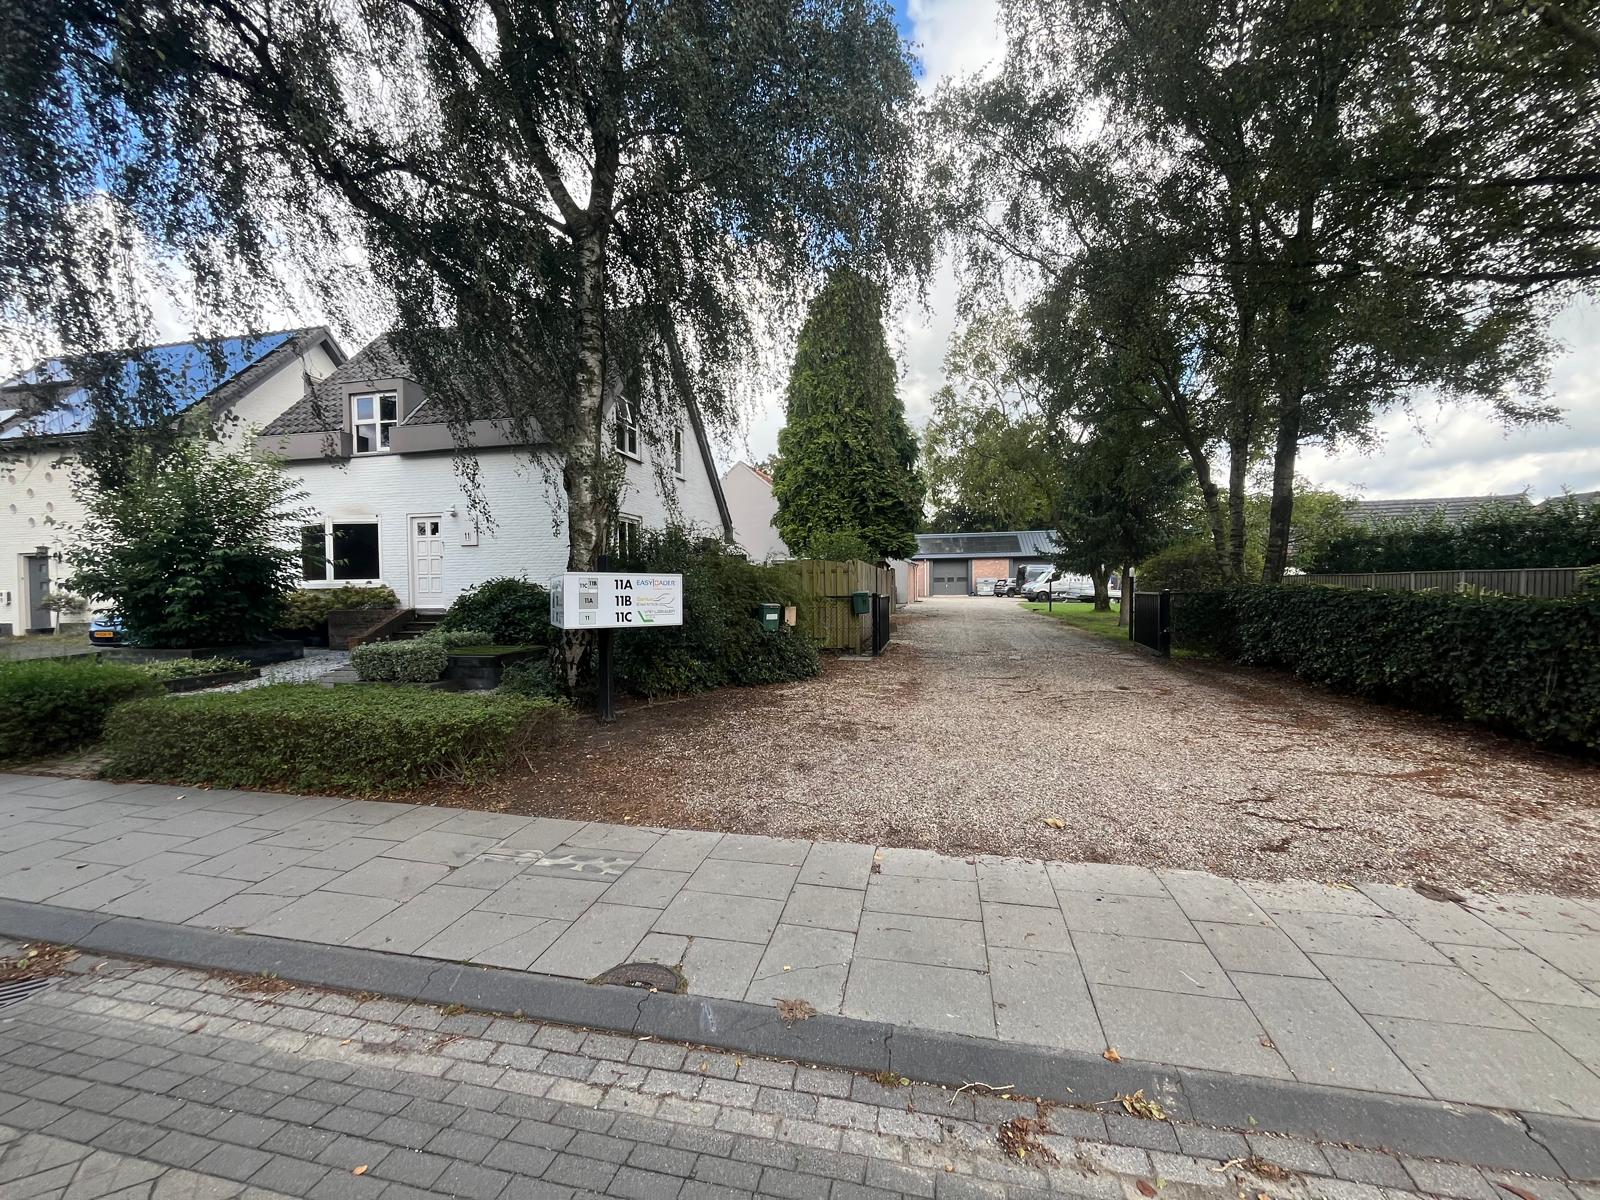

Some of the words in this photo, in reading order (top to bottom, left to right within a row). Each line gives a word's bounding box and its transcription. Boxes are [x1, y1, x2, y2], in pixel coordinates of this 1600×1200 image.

[614, 579, 633, 590] 11A
[615, 595, 632, 607] 11B
[615, 611, 632, 623] 11C
